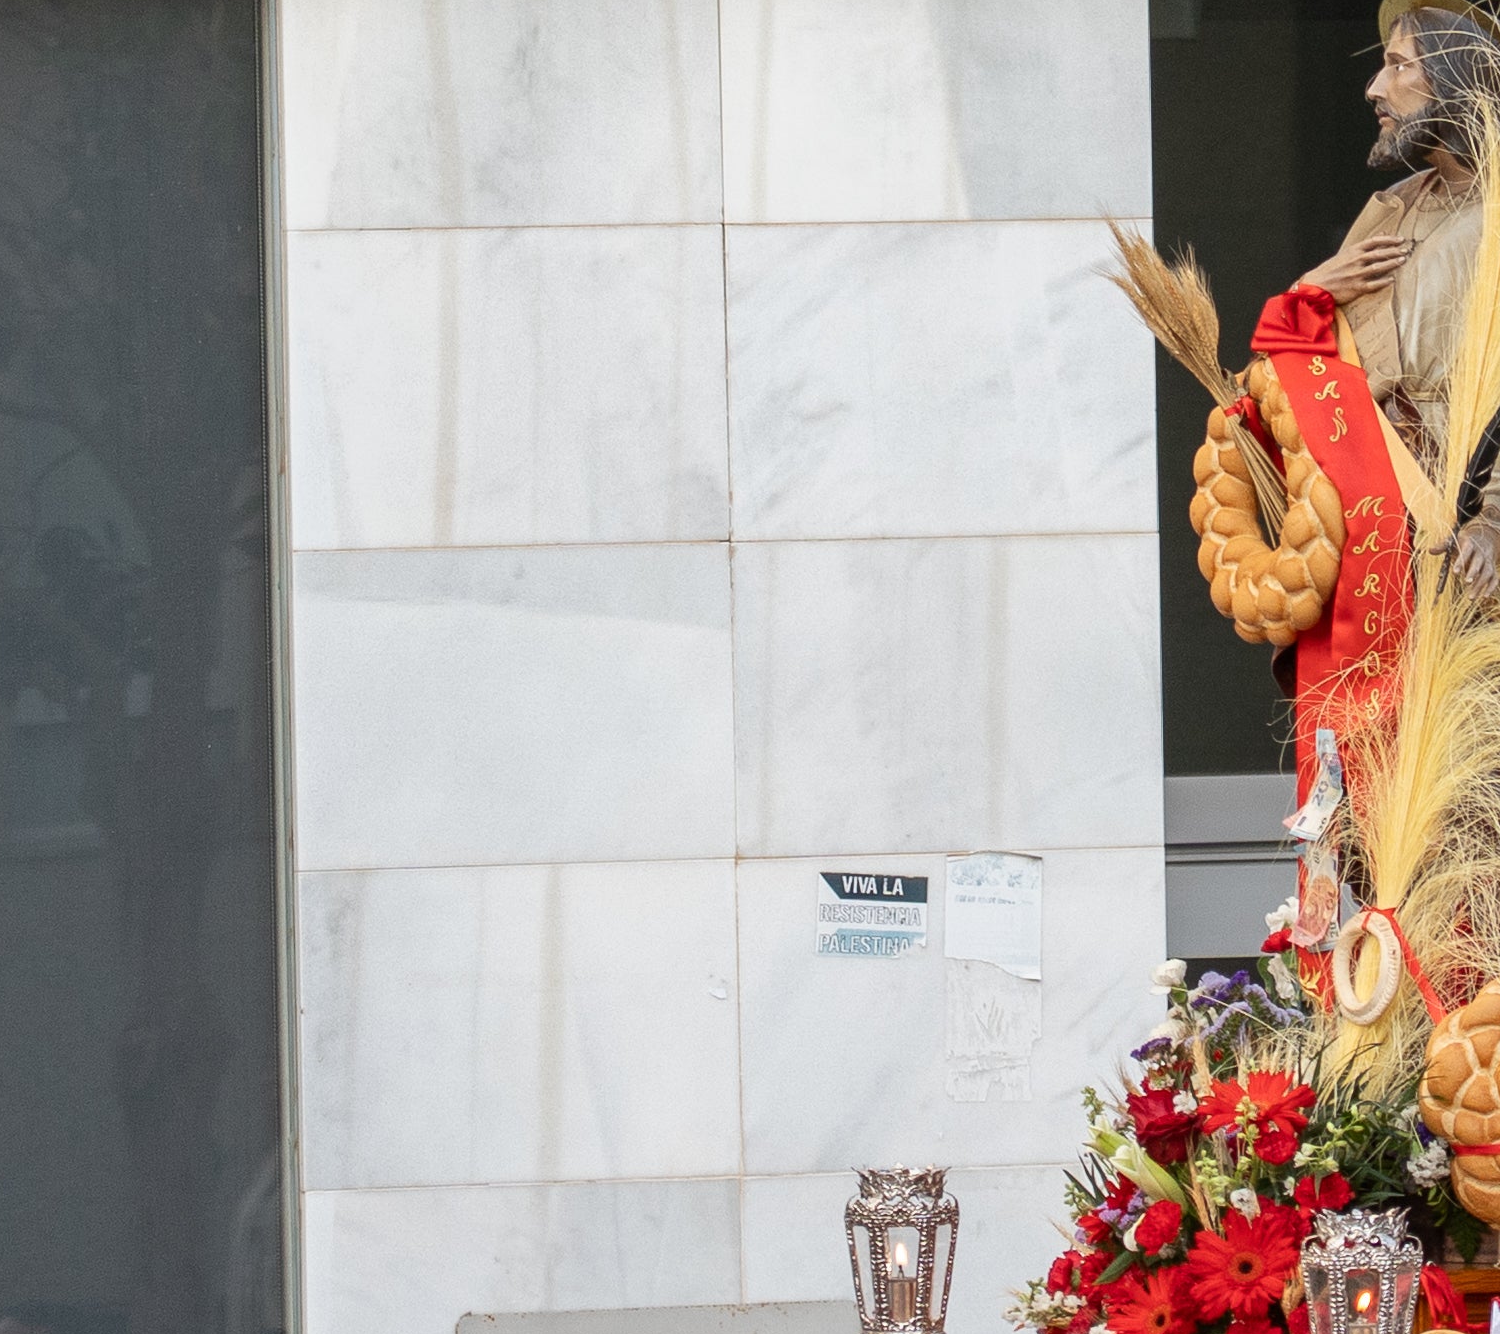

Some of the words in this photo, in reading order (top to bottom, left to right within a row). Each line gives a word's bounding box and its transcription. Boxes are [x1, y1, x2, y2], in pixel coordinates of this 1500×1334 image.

[842, 875, 878, 895] VIVA
[883, 877, 904, 896] LA
[819, 903, 922, 926] RESISTENCIA
